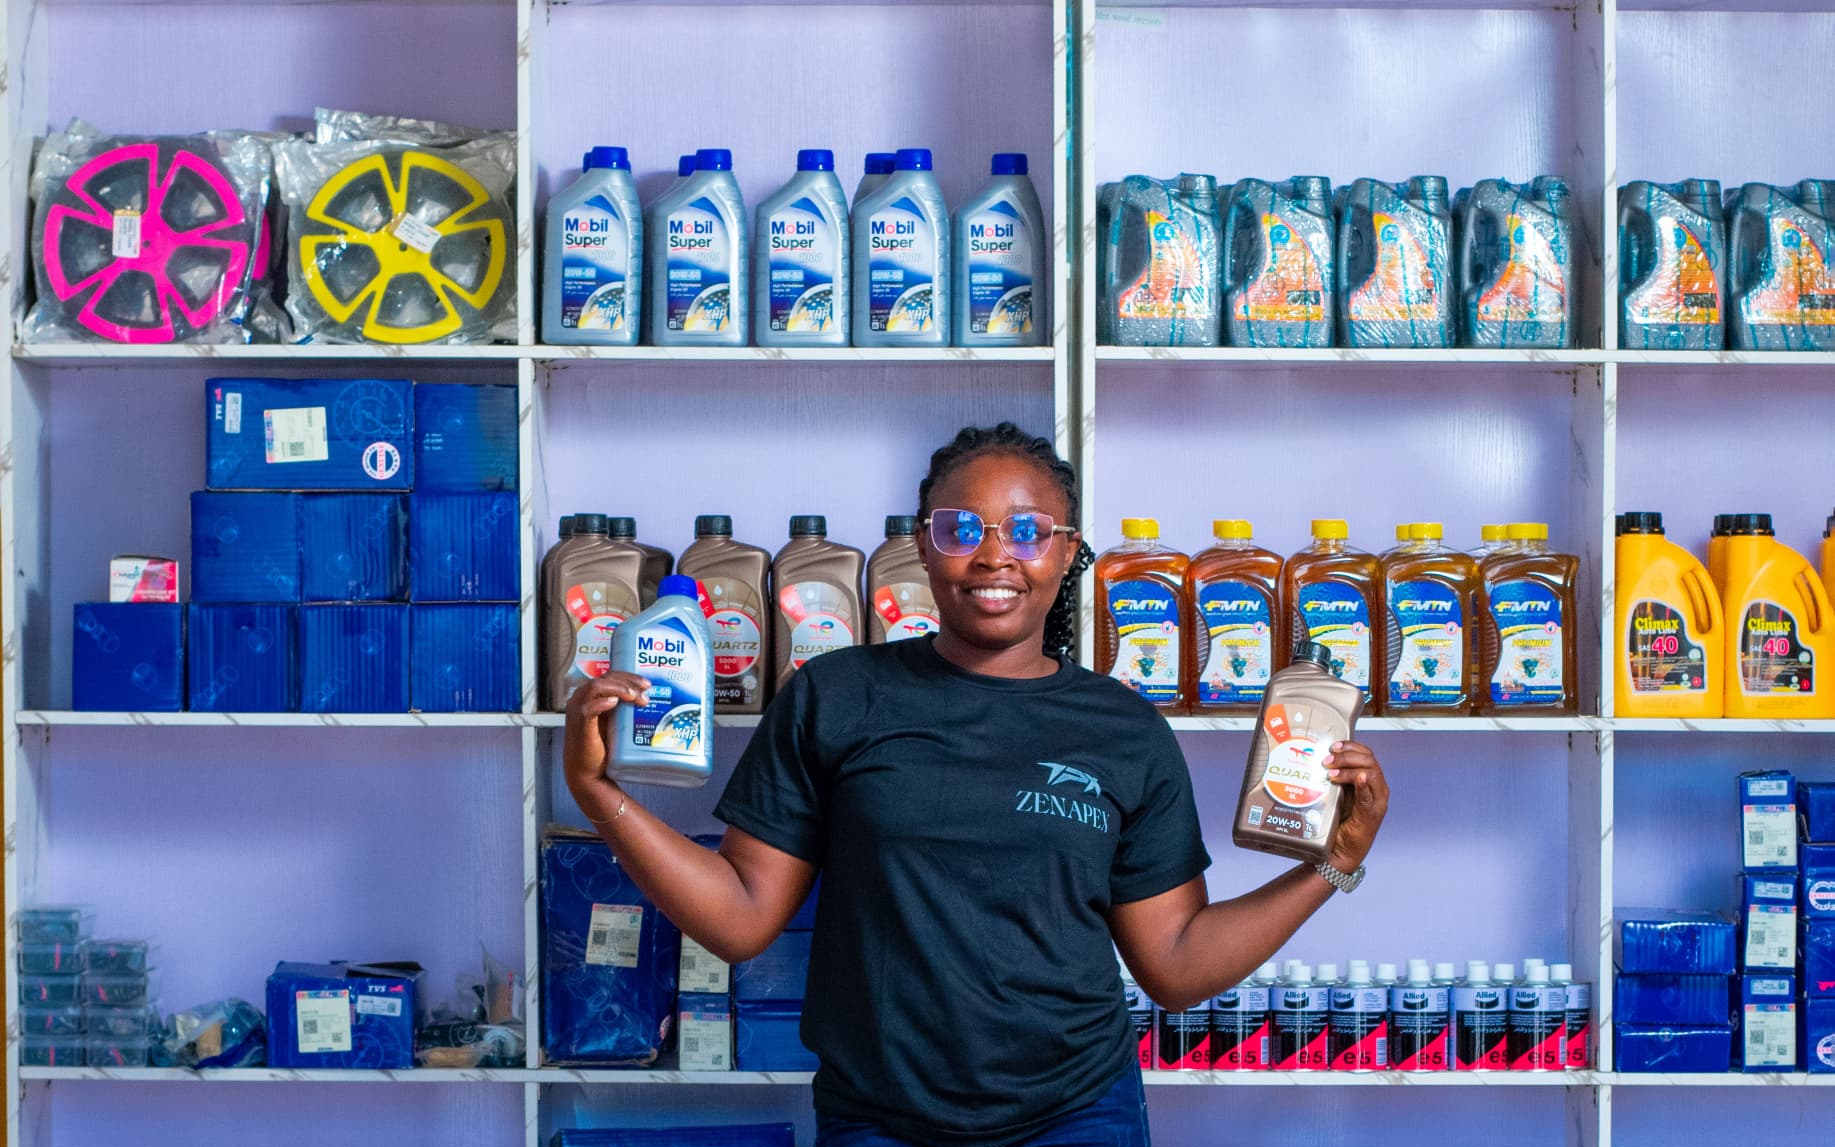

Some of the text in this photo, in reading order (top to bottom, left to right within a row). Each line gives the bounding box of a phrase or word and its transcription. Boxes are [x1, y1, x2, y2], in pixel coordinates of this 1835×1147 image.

[565, 218, 608, 232] Mobil
[670, 220, 712, 234] Mobil
[772, 221, 814, 234] Mobil
[872, 221, 914, 234] Mobil
[970, 224, 1013, 238] Mobil
[565, 234, 607, 248] Super
[670, 236, 712, 250] Super
[772, 237, 814, 250] Super
[872, 237, 914, 250] Super
[971, 240, 1013, 252] Super
[599, 307, 621, 318] XHP
[703, 308, 727, 320] XHP
[807, 309, 829, 320] XHP
[907, 309, 929, 319] XHP
[1007, 312, 1029, 322] XHP
[1635, 616, 1679, 630] Climax
[1748, 616, 1792, 631] Climax
[638, 636, 685, 654] Mobil
[712, 641, 758, 650] UARTZ
[1652, 636, 1678, 654] 40
[1763, 638, 1789, 656] 40
[638, 652, 684, 667] Super
[649, 687, 671, 696] W-50
[714, 689, 740, 698] 0W-50
[674, 728, 697, 740] XHP
[1285, 785, 1304, 796] 5000
[1016, 790, 1110, 832] ZENAPEX
[1266, 815, 1301, 830] 20W-50
[1229, 1051, 1256, 1064] e5
[1300, 1051, 1322, 1064] e5
[1344, 1051, 1371, 1065] e5
[1418, 1052, 1442, 1064] e5
[1528, 1051, 1555, 1064] e5
